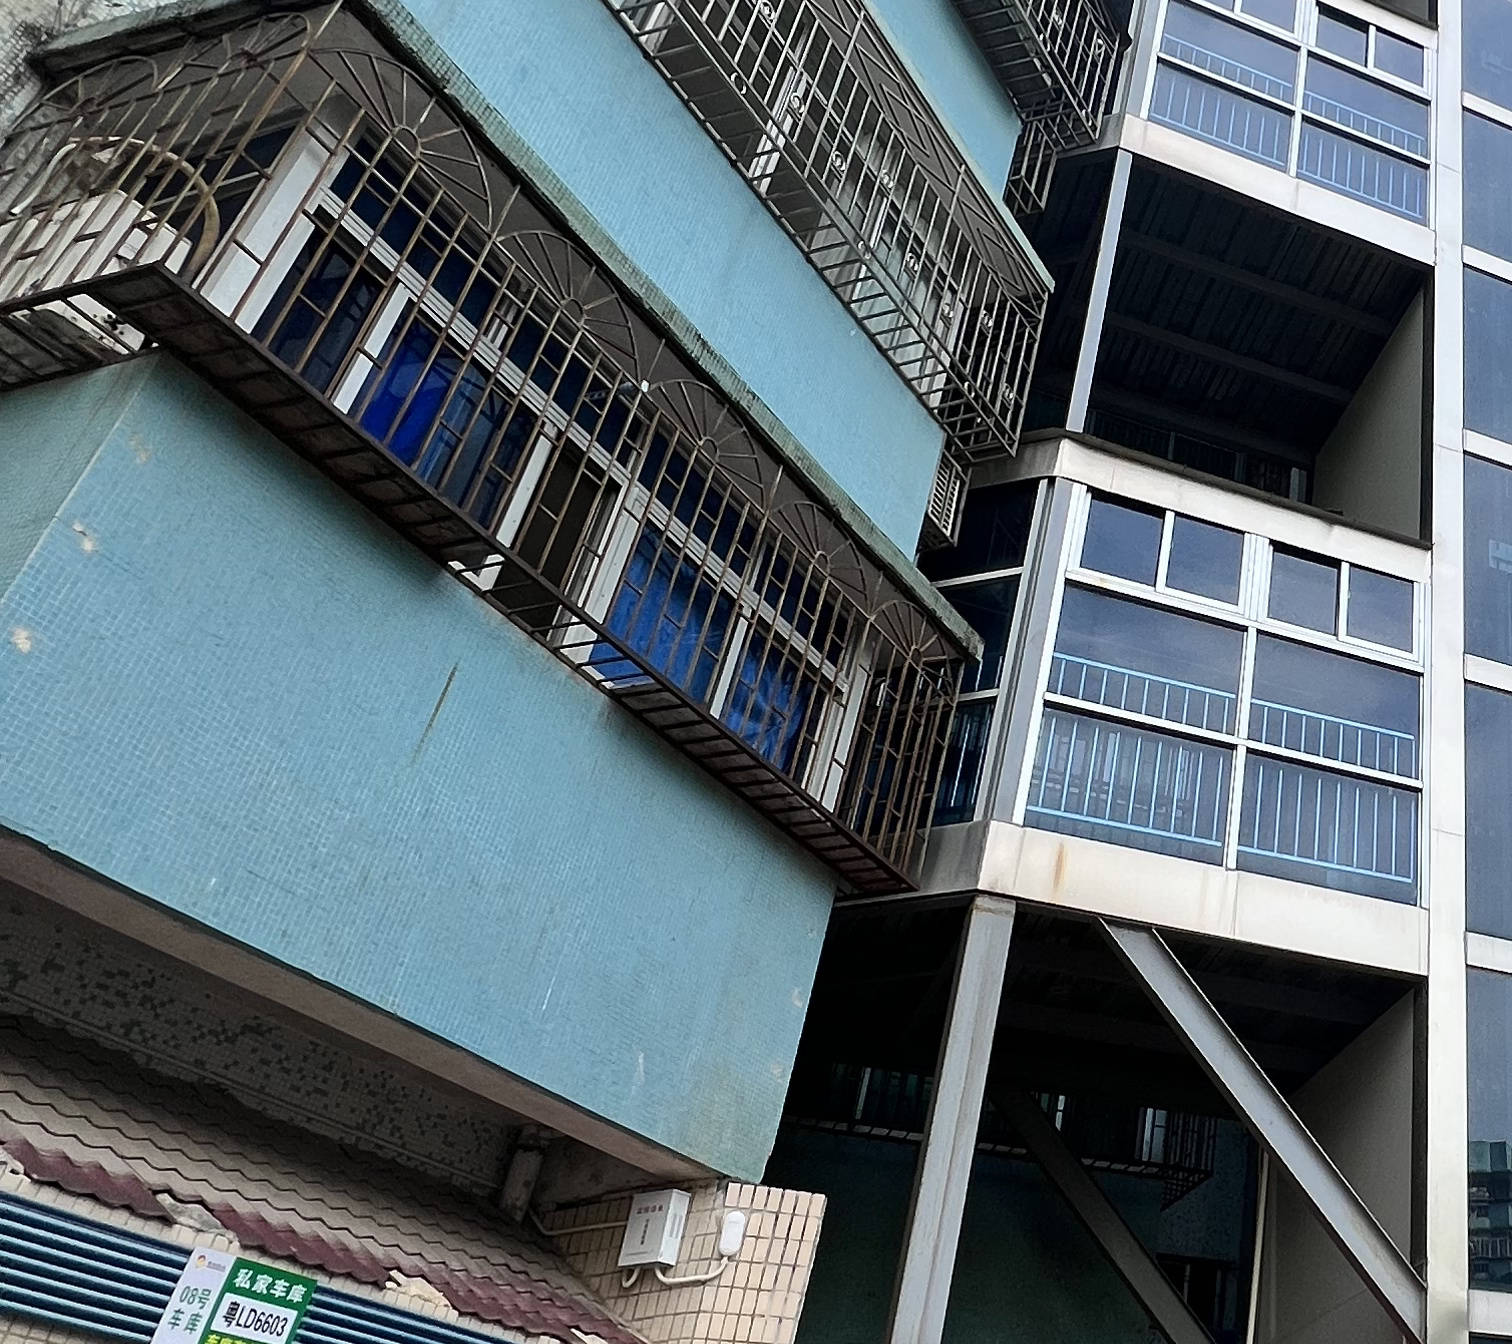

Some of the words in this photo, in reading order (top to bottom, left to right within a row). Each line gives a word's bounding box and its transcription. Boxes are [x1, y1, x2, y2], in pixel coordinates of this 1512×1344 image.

[179, 1285, 212, 1310] 08号
[233, 1268, 308, 1304] 私家车库
[167, 1308, 204, 1335] 车库
[222, 1300, 289, 1337] 粤LD6603
